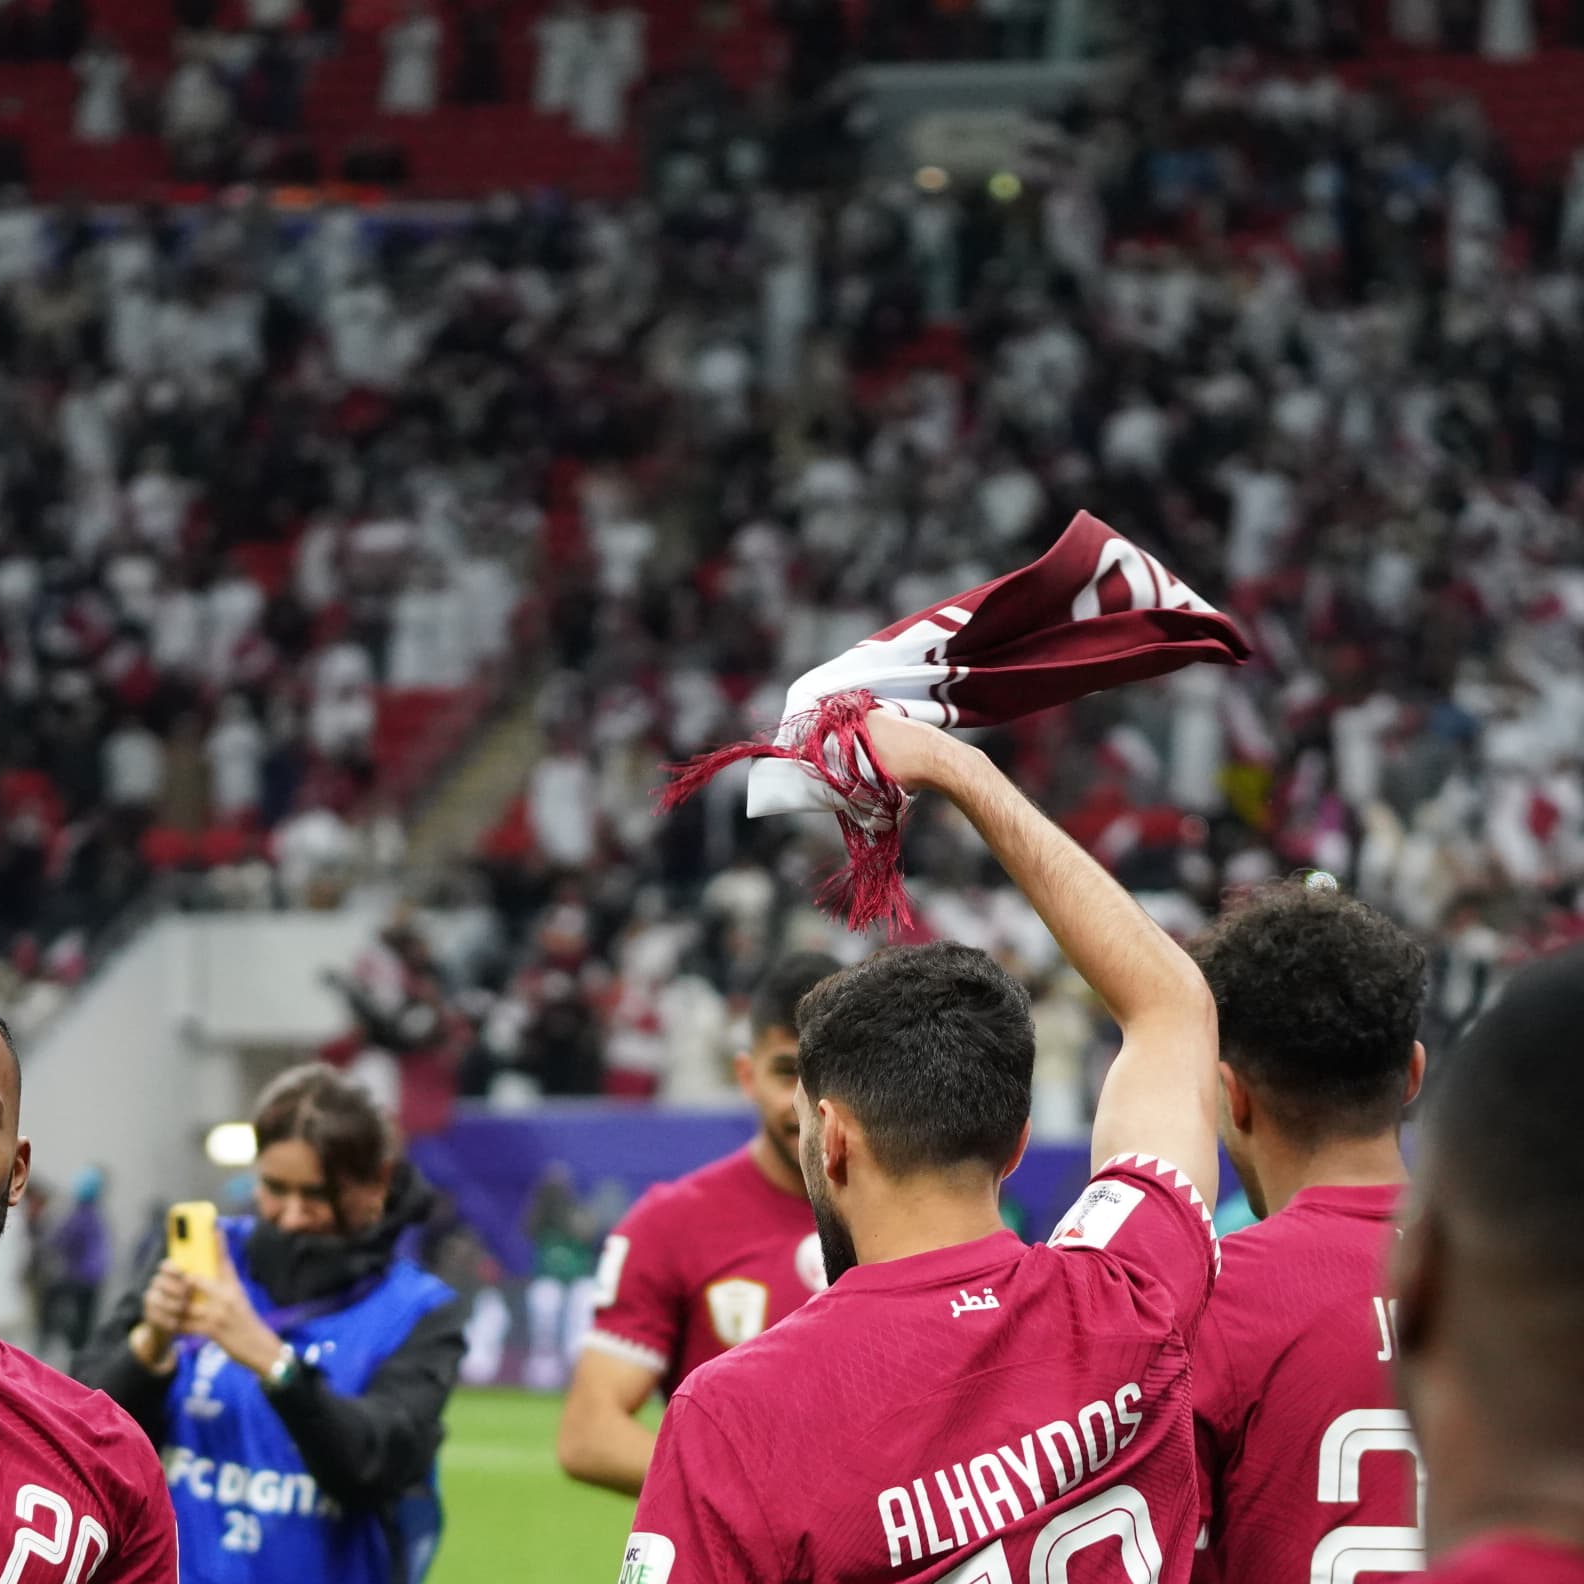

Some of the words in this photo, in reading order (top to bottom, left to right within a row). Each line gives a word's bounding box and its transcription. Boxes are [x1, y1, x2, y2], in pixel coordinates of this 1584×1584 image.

[950, 1288, 1000, 1318] قطر
[161, 1446, 215, 1500] FC
[877, 1382, 1144, 1568] ALHAYDOS
